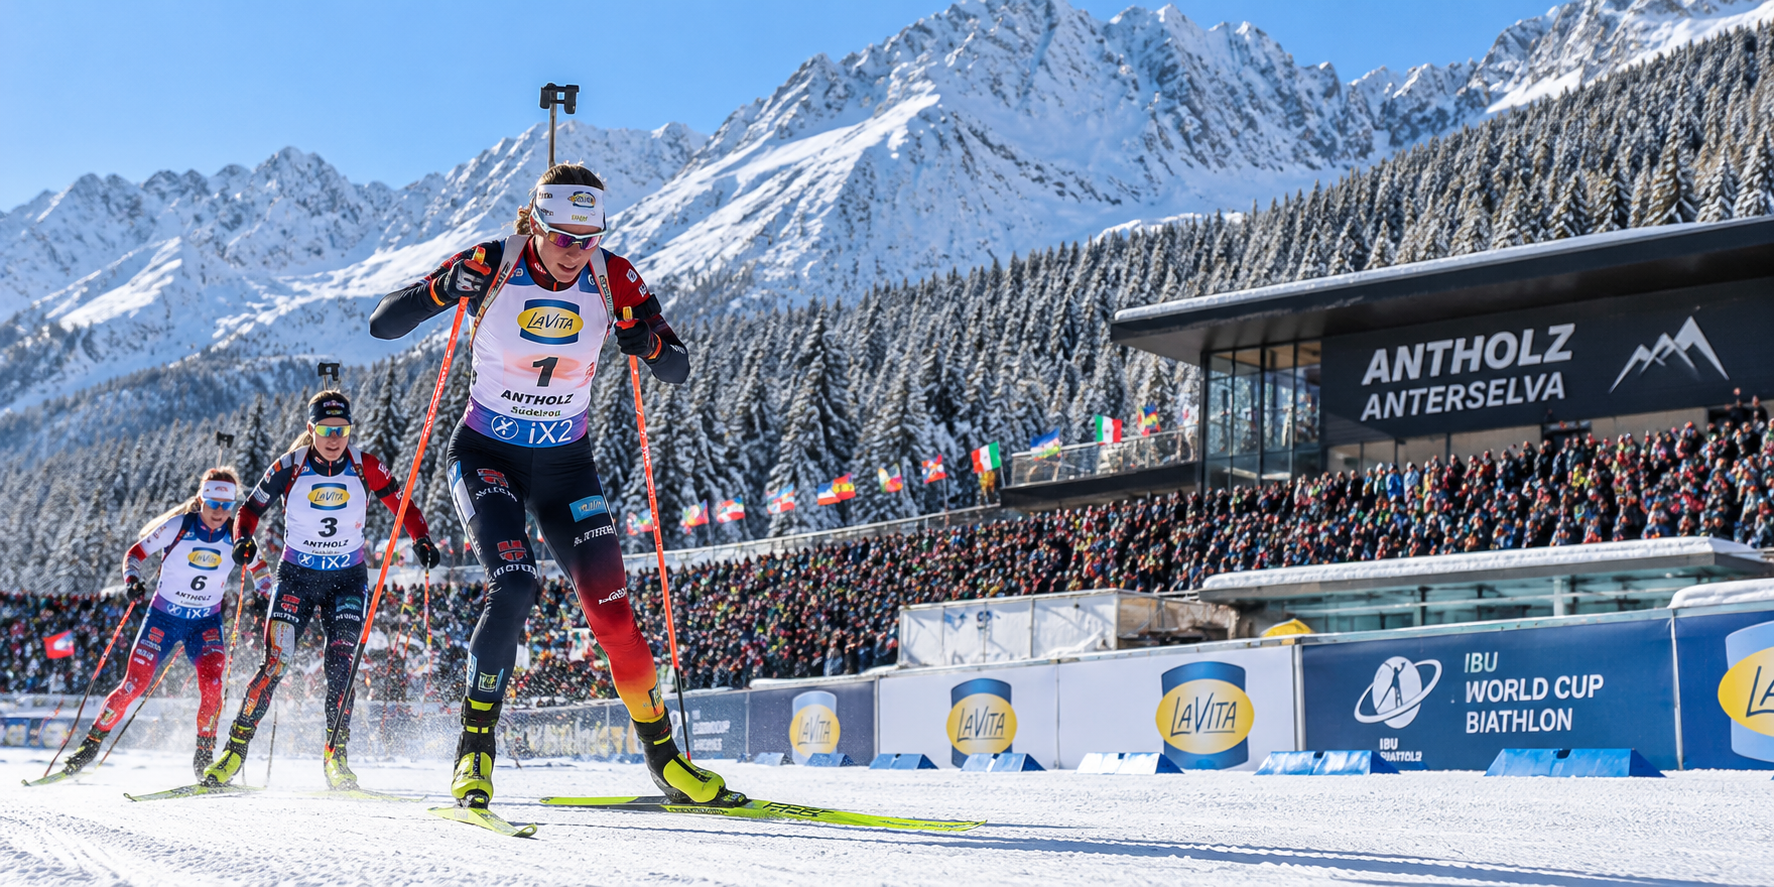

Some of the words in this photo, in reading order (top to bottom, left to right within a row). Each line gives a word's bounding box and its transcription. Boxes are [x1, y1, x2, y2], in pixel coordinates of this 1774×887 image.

[1361, 322, 1576, 386] ANTHOLZ
[532, 356, 559, 388] 1
[501, 389, 574, 405] ANTHOLZ
[1360, 371, 1566, 422] ANTERSELVA
[528, 419, 573, 444] iX2
[318, 517, 338, 537] 3
[303, 539, 349, 548] ANTHOLZ
[321, 553, 351, 570] iX2
[190, 575, 208, 591] 6
[186, 607, 211, 619] iX2
[1464, 651, 1498, 674] IBU
[1465, 676, 1549, 704] WORLD
[1554, 673, 1604, 700] CUP
[1466, 707, 1573, 734] BIATHLON
[1379, 737, 1399, 750] IBU
